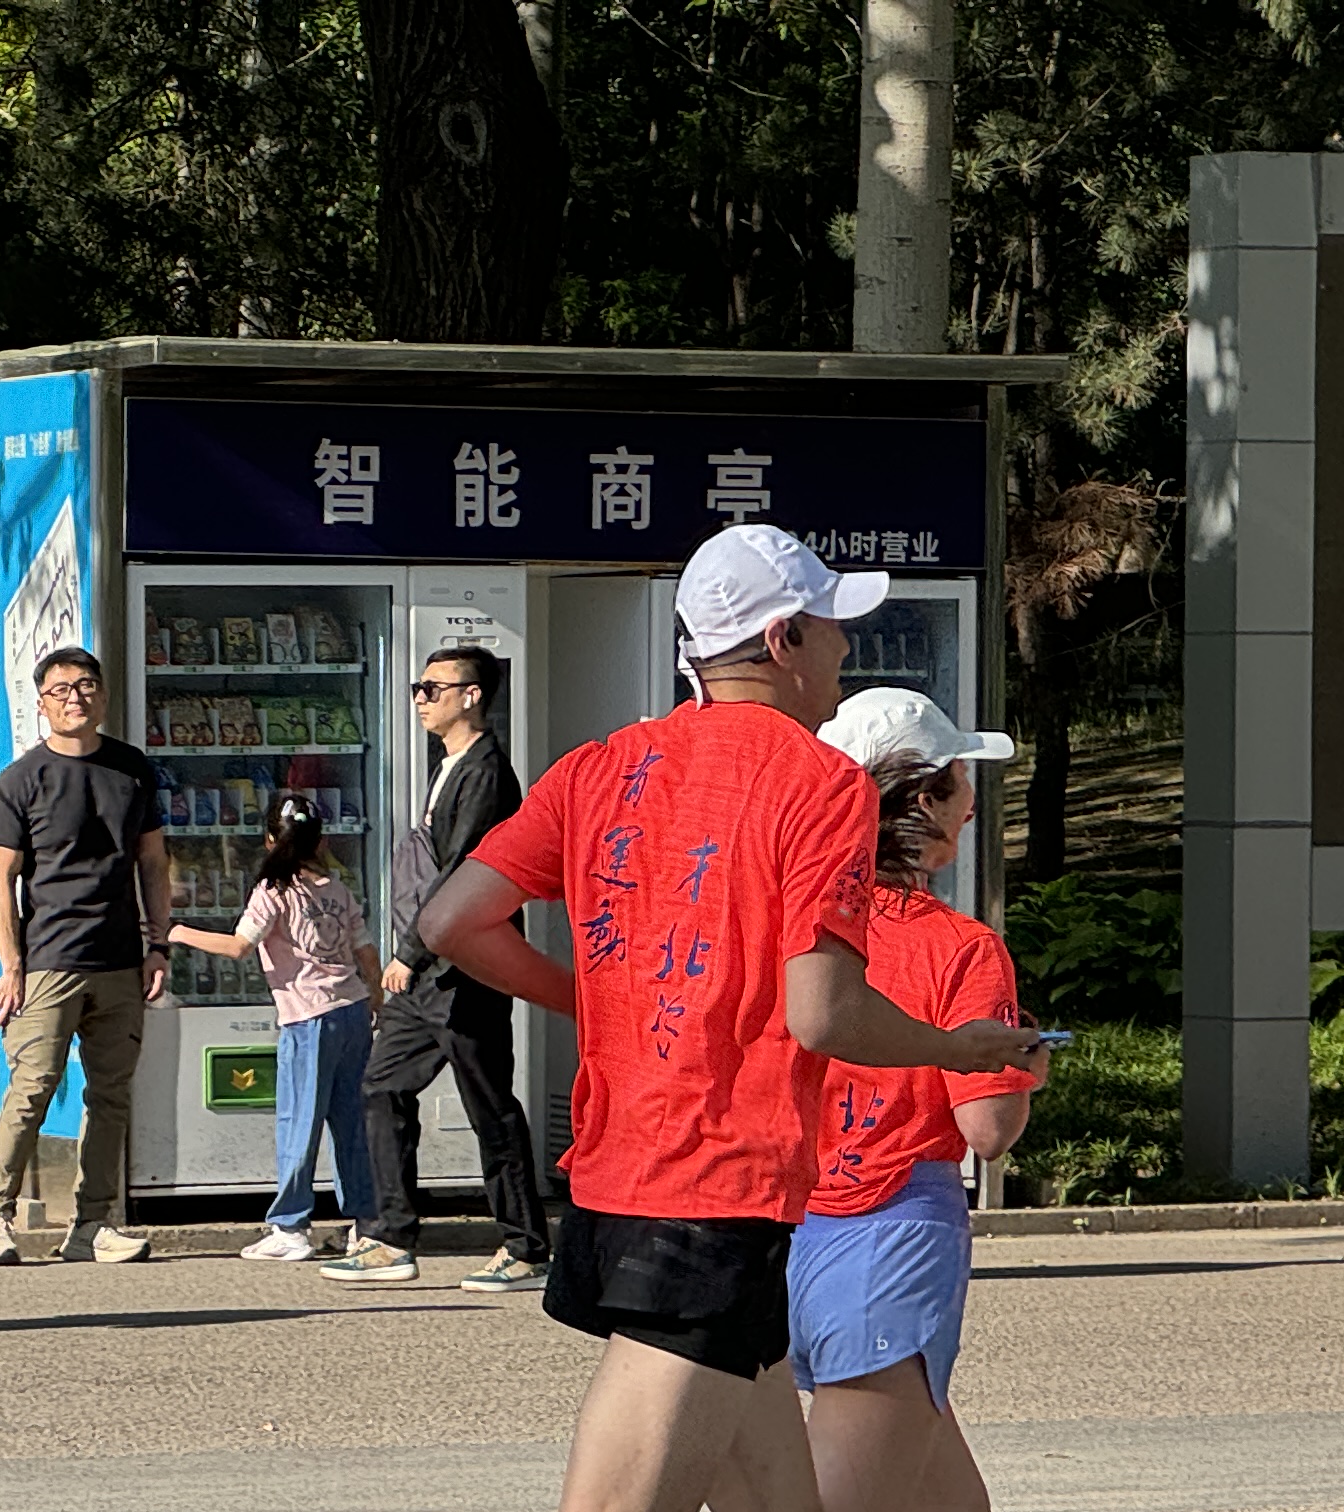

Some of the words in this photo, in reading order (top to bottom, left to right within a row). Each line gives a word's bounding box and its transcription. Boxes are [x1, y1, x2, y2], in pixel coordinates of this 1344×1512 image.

[314, 437, 772, 530] 智能商亭
[786, 529, 941, 563] 4小时营业
